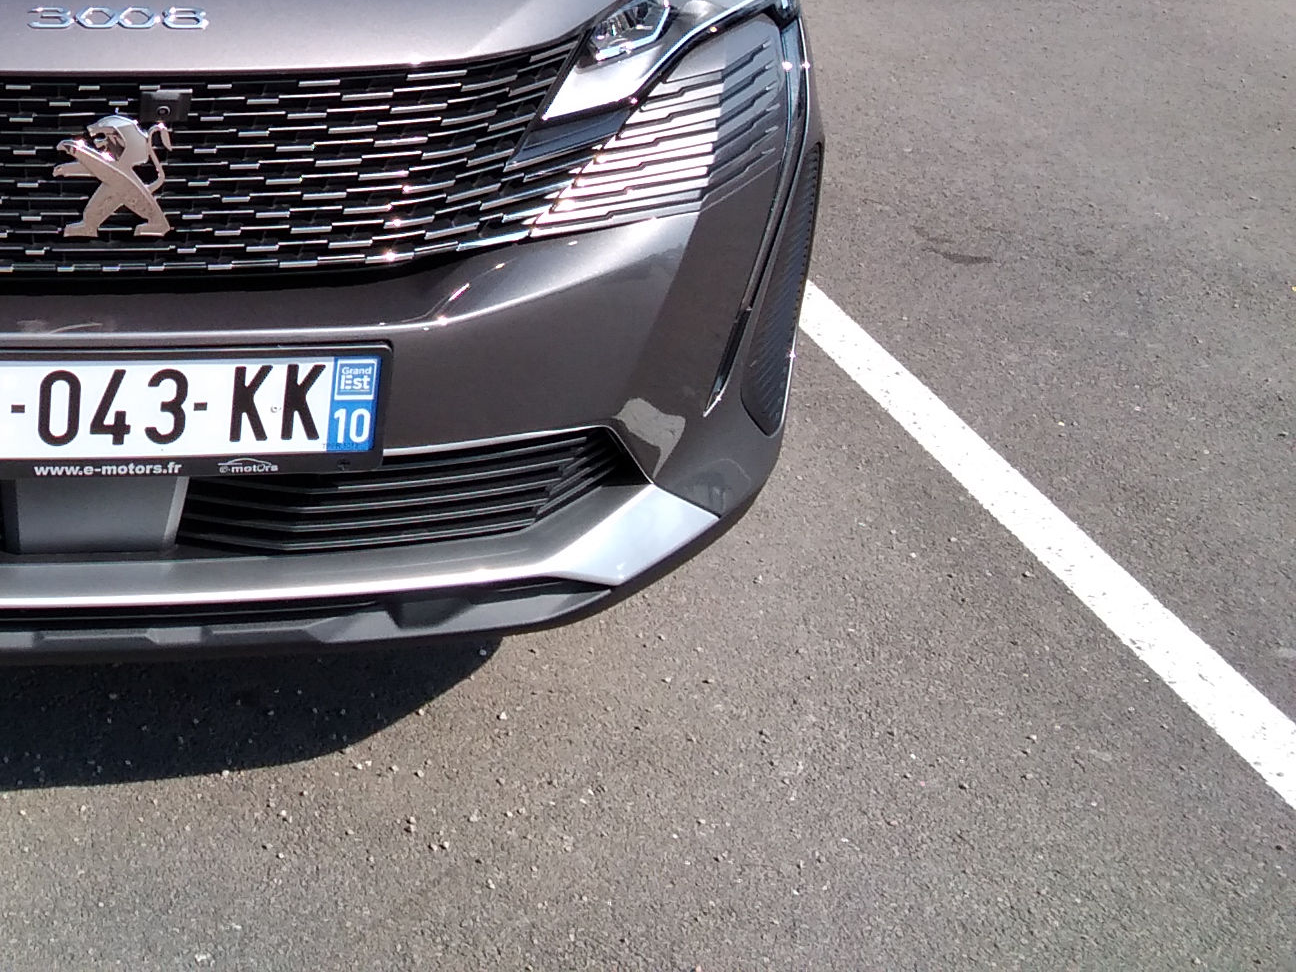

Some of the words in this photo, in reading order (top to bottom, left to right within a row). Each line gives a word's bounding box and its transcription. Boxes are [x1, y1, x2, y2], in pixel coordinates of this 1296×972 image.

[27, 6, 210, 30] 3008
[341, 366, 373, 375] Grand
[340, 374, 371, 390] Est
[333, 408, 371, 444] 10
[33, 461, 183, 476] www.e-motors.fr
